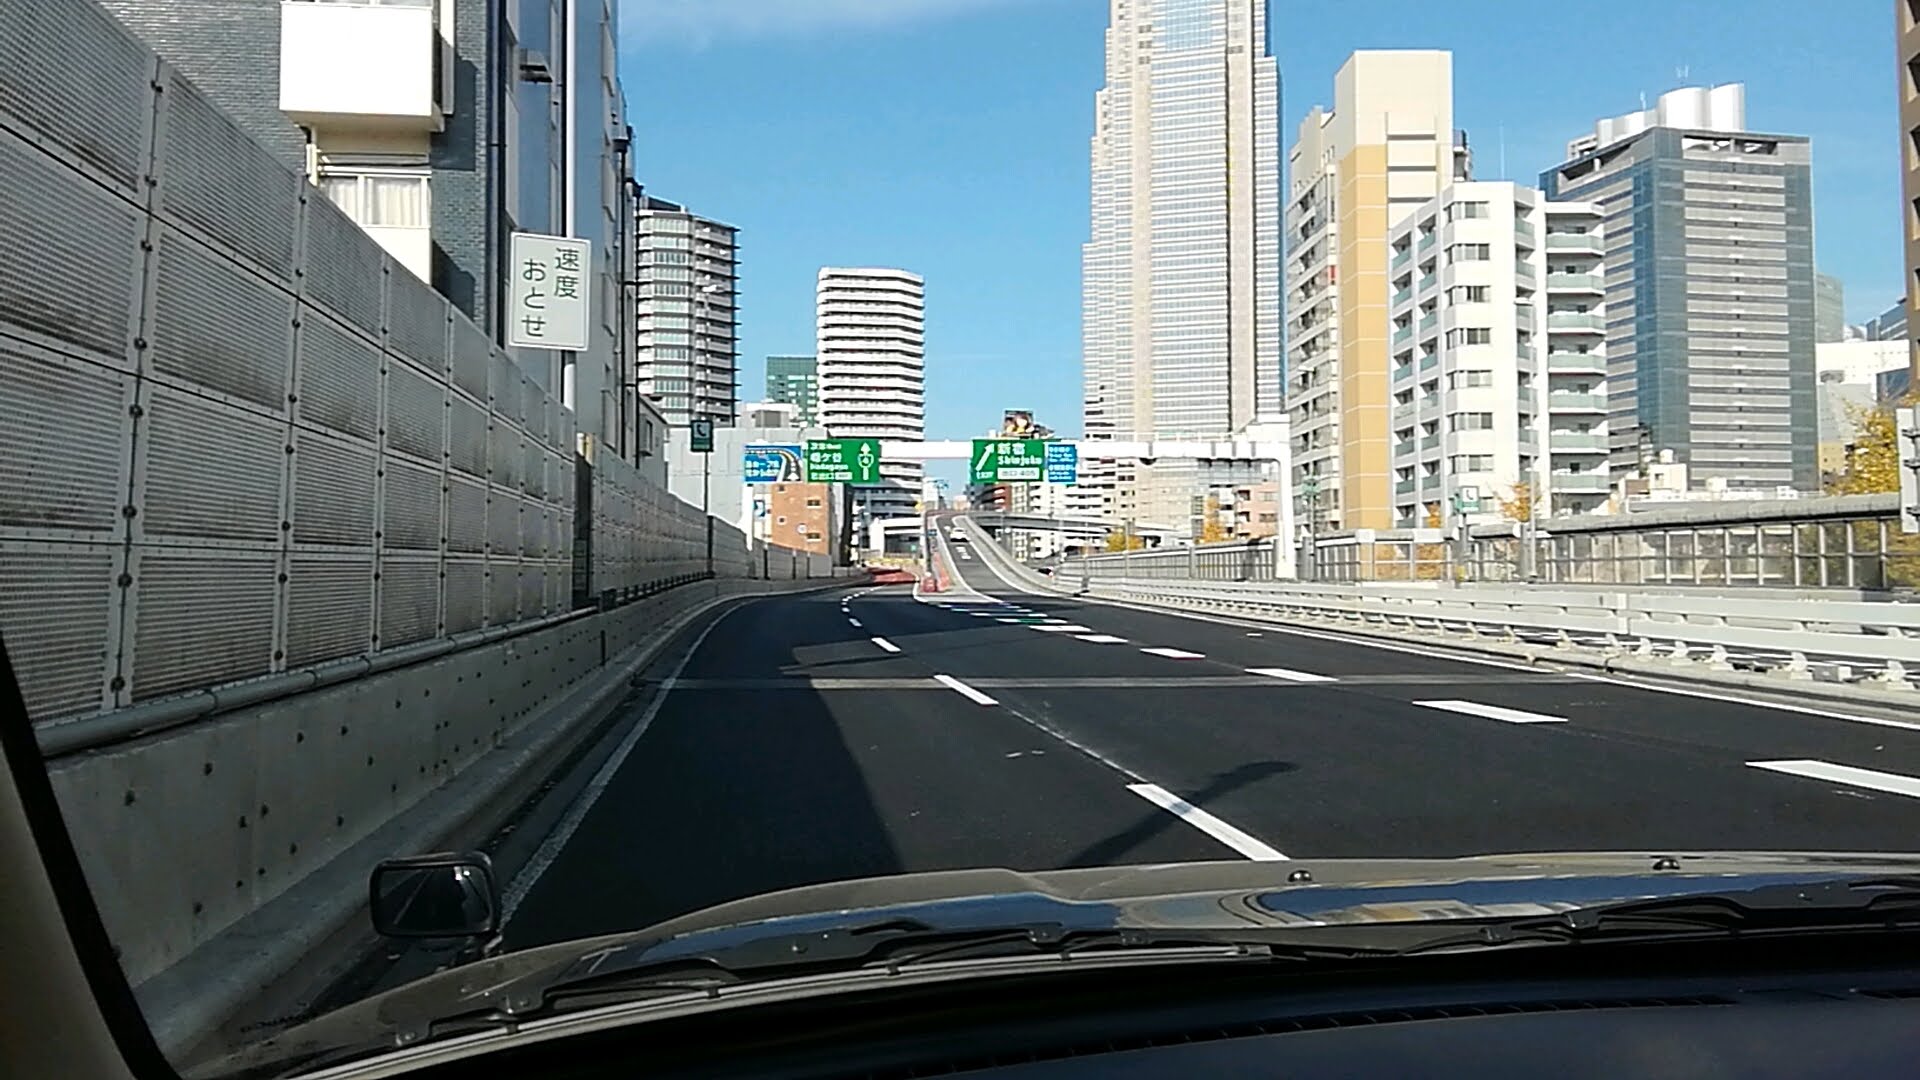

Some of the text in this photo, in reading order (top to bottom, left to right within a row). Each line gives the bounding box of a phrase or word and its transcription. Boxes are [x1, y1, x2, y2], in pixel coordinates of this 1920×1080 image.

[554, 247, 580, 300] 速度
[521, 257, 547, 338] おとせ
[997, 443, 1025, 455] 新宿
[997, 455, 1041, 467] Shinjuku
